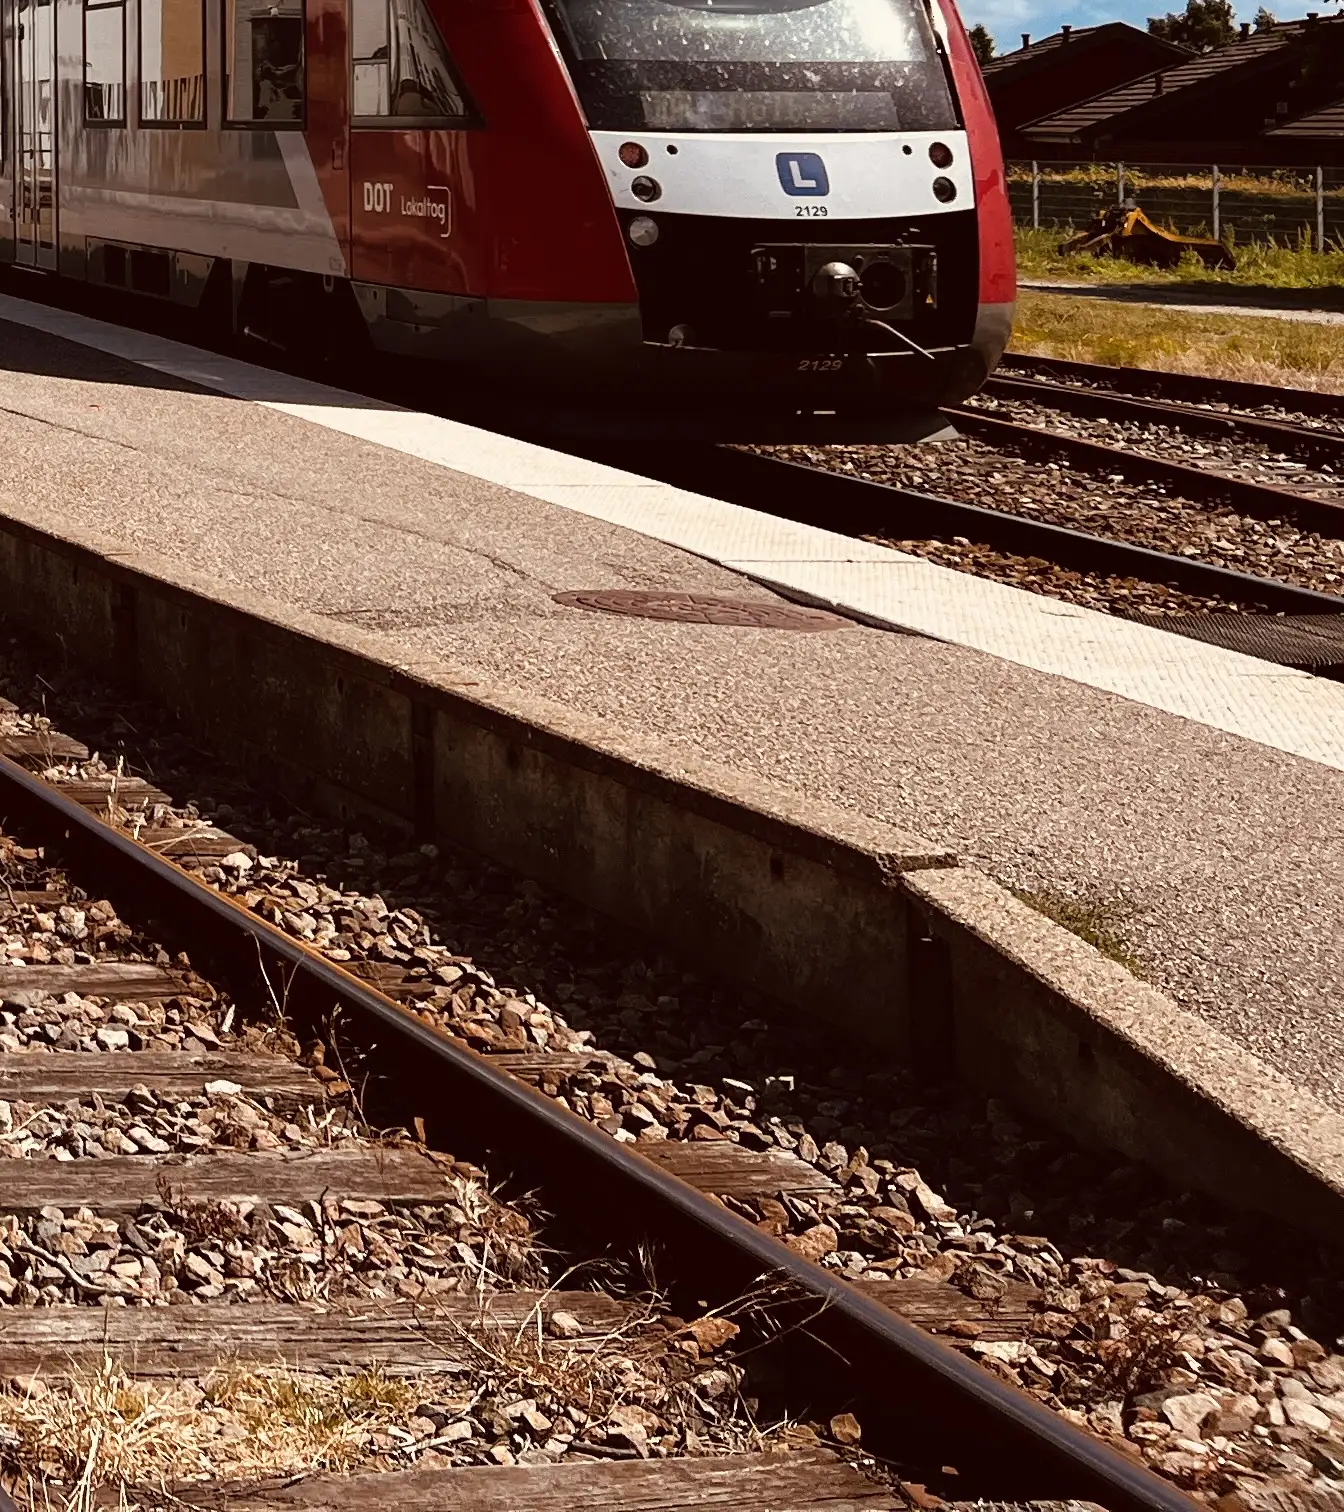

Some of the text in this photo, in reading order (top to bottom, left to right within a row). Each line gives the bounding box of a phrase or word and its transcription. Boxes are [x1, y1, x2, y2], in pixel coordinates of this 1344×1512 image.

[789, 160, 817, 188] L
[364, 182, 446, 225] DOT Lokaltog
[795, 206, 828, 217] 2129
[797, 360, 842, 371] 2129
